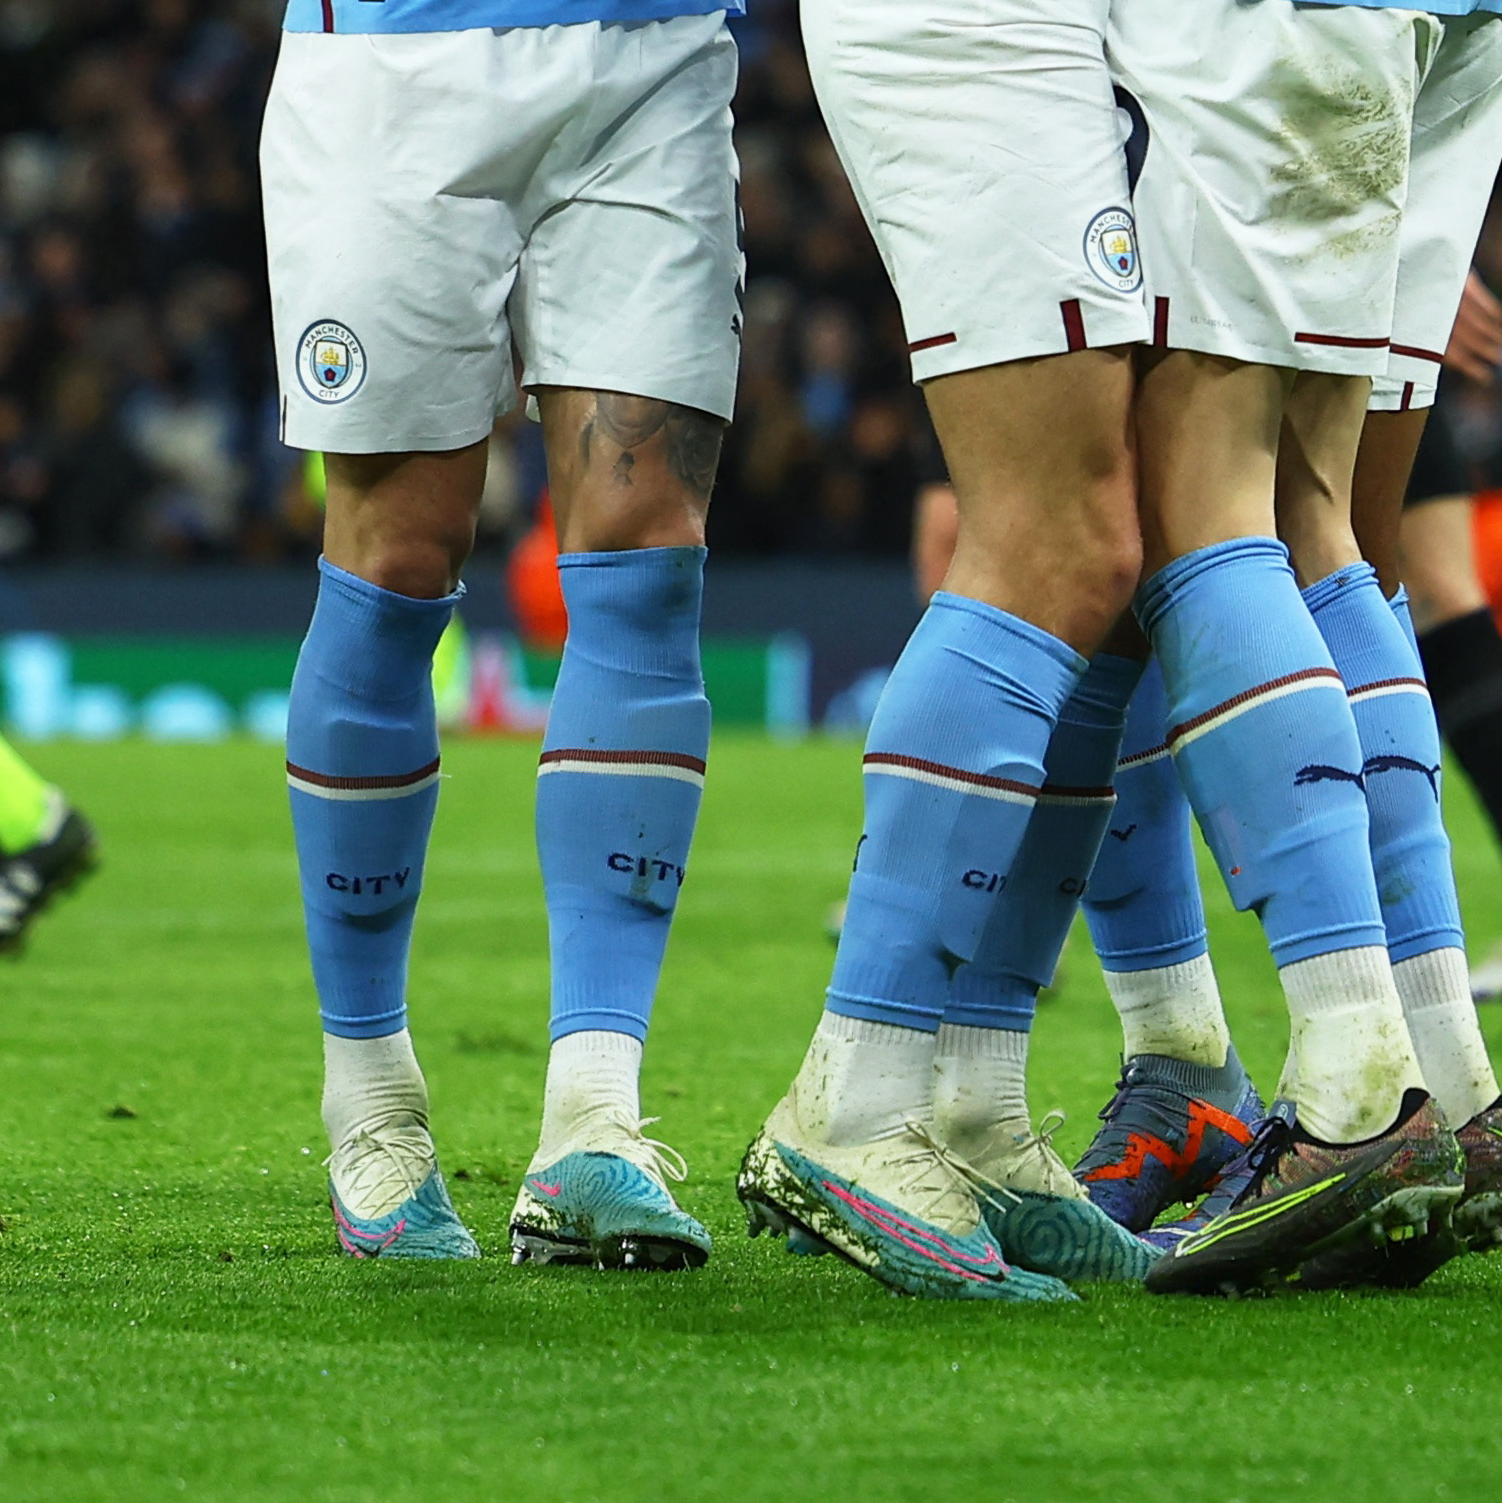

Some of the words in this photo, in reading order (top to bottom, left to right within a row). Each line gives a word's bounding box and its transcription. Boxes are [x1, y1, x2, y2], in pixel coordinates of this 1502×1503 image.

[305, 325, 359, 355] MANCHESTER
[318, 389, 340, 399] CITY
[326, 866, 410, 895] CITY
[1058, 877, 1087, 897] CI
